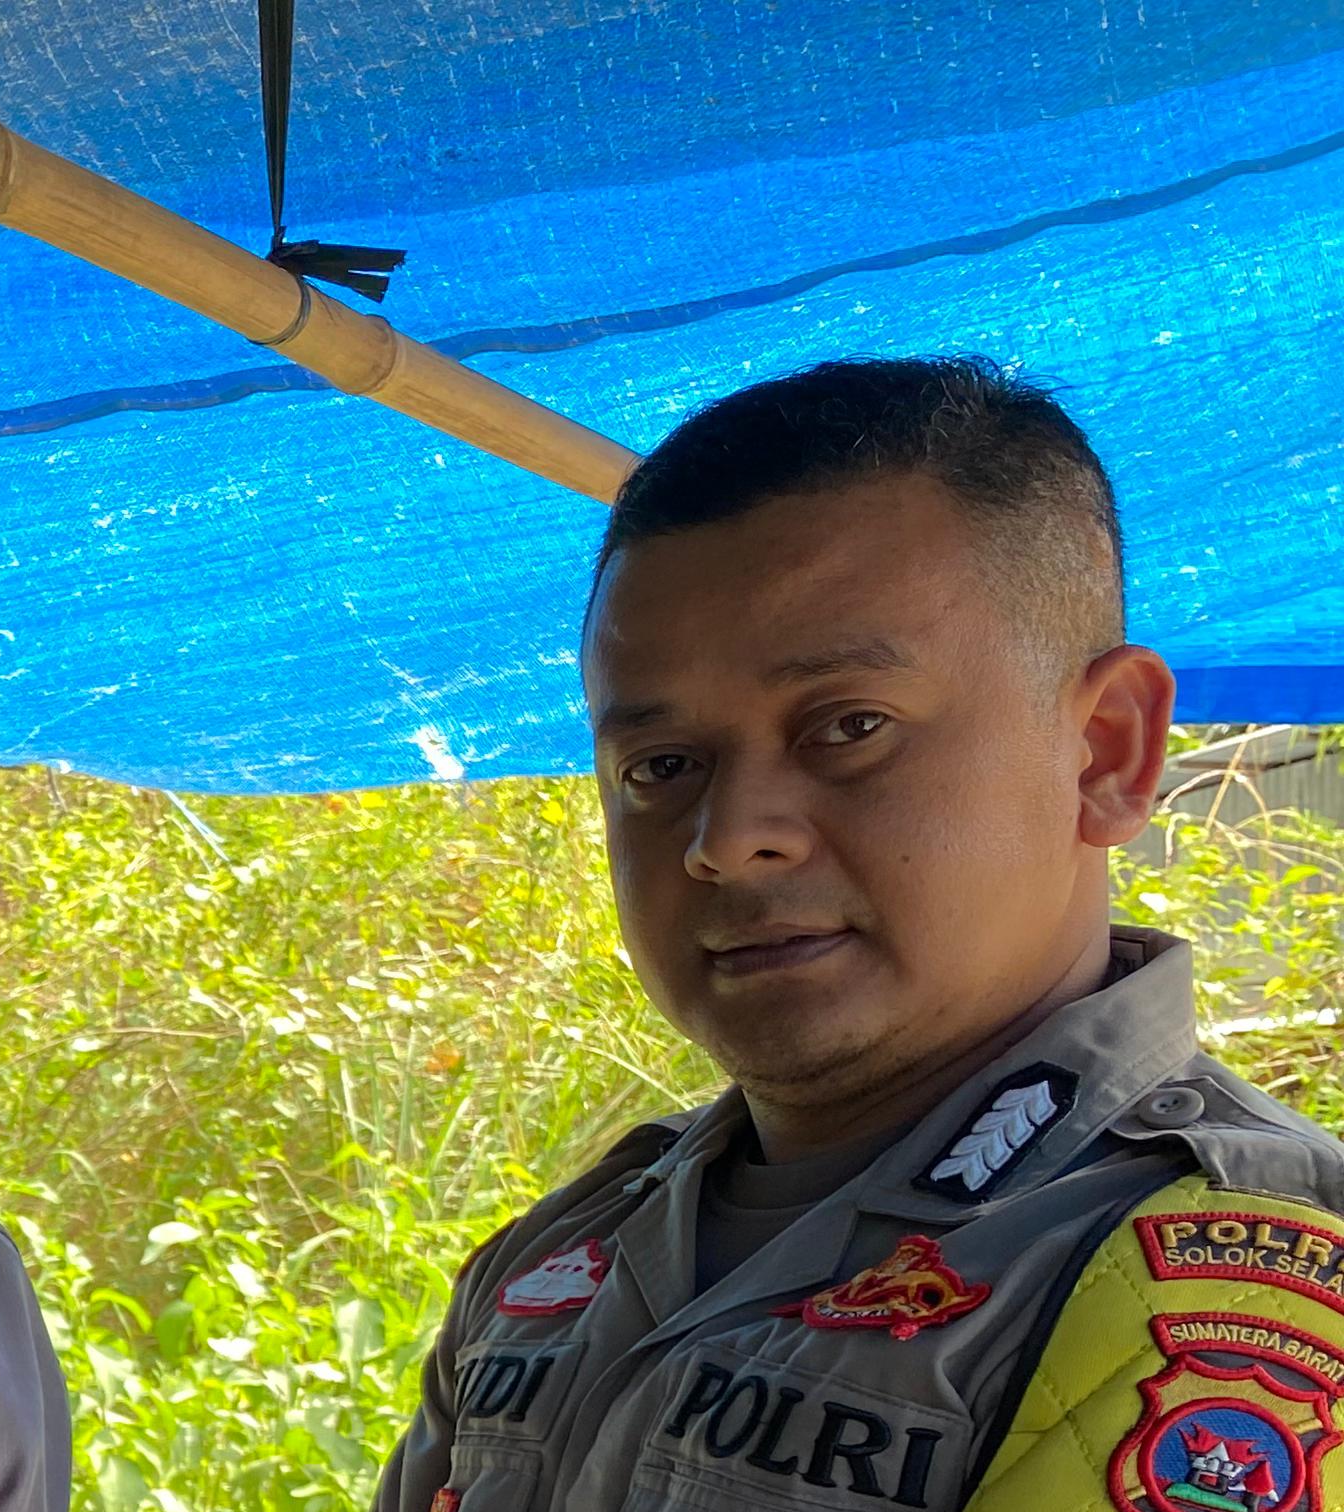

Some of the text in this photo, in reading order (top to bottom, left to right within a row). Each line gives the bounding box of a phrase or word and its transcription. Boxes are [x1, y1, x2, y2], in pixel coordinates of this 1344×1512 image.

[1161, 1220, 1344, 1272] POLR
[1274, 1254, 1344, 1298] SELA
[665, 1362, 944, 1509] POLRI
